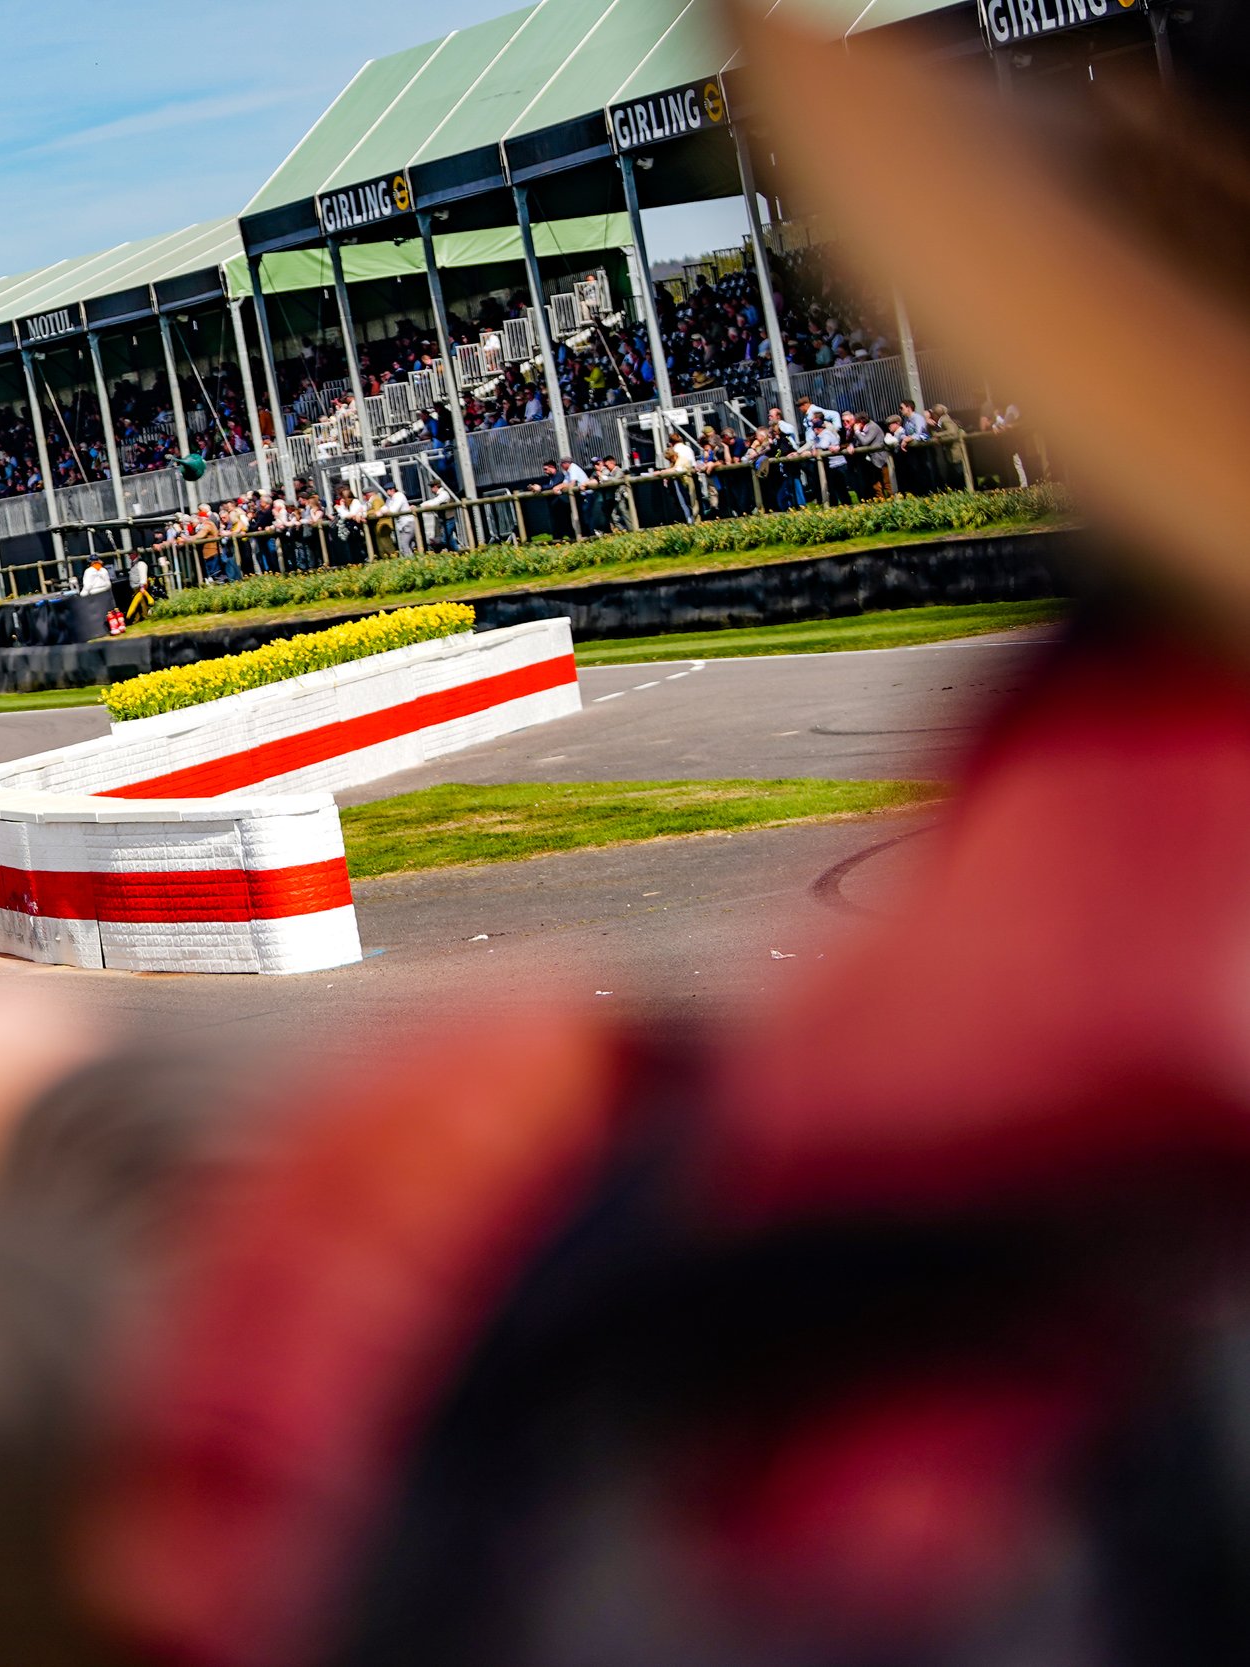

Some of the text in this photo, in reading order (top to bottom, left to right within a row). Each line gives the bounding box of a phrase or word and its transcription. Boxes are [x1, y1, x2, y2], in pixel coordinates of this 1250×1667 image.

[613, 89, 702, 149] GIRLING
[322, 180, 392, 233] GIRLING
[26, 309, 75, 341] MOTUL
